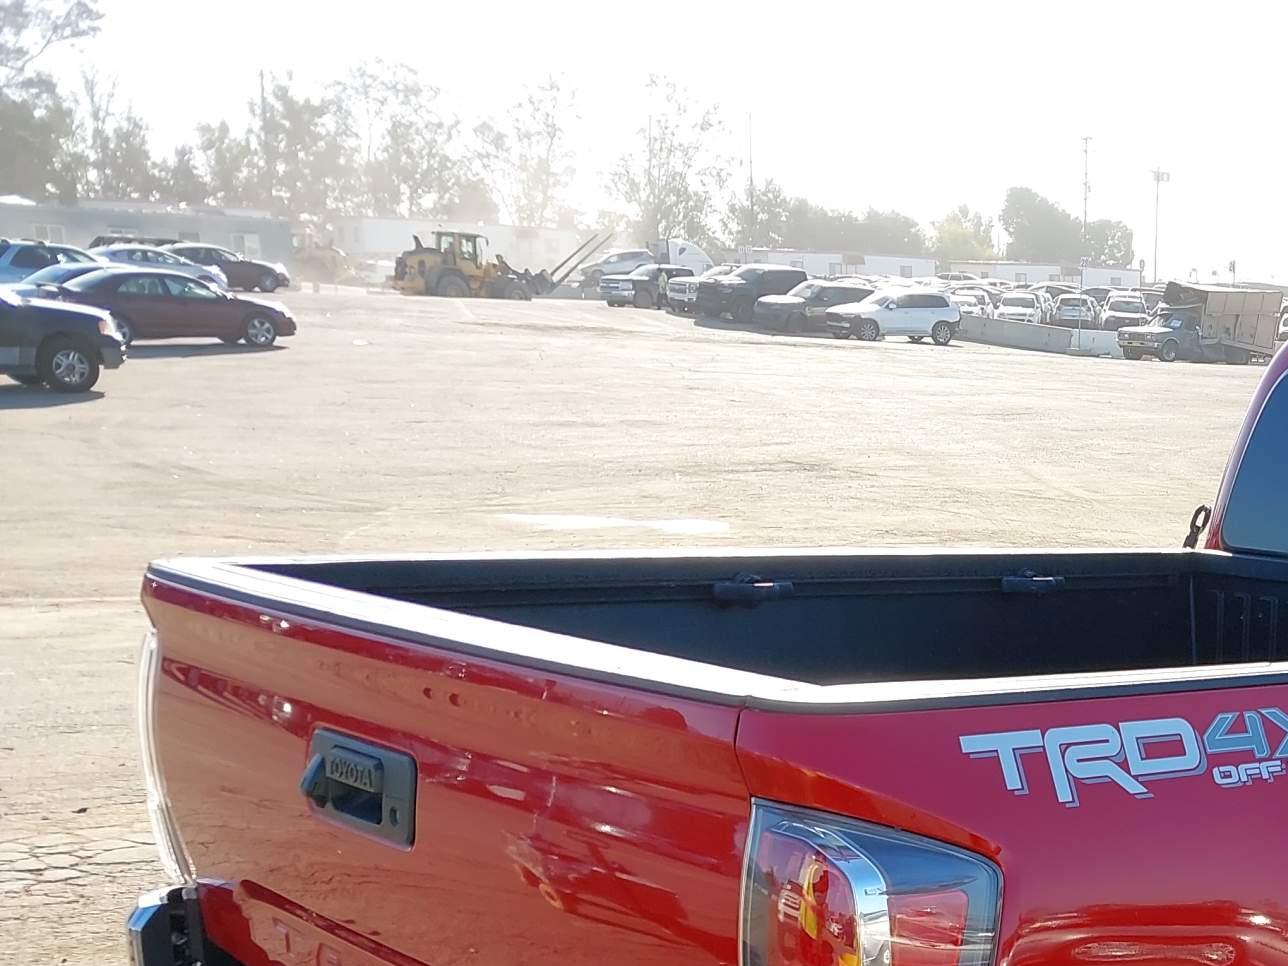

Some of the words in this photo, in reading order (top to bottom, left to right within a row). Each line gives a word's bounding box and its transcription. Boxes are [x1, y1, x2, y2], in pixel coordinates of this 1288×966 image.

[326, 757, 374, 789] TOYOTA
[958, 716, 1207, 807] TRD
[1212, 758, 1287, 789] OFF
